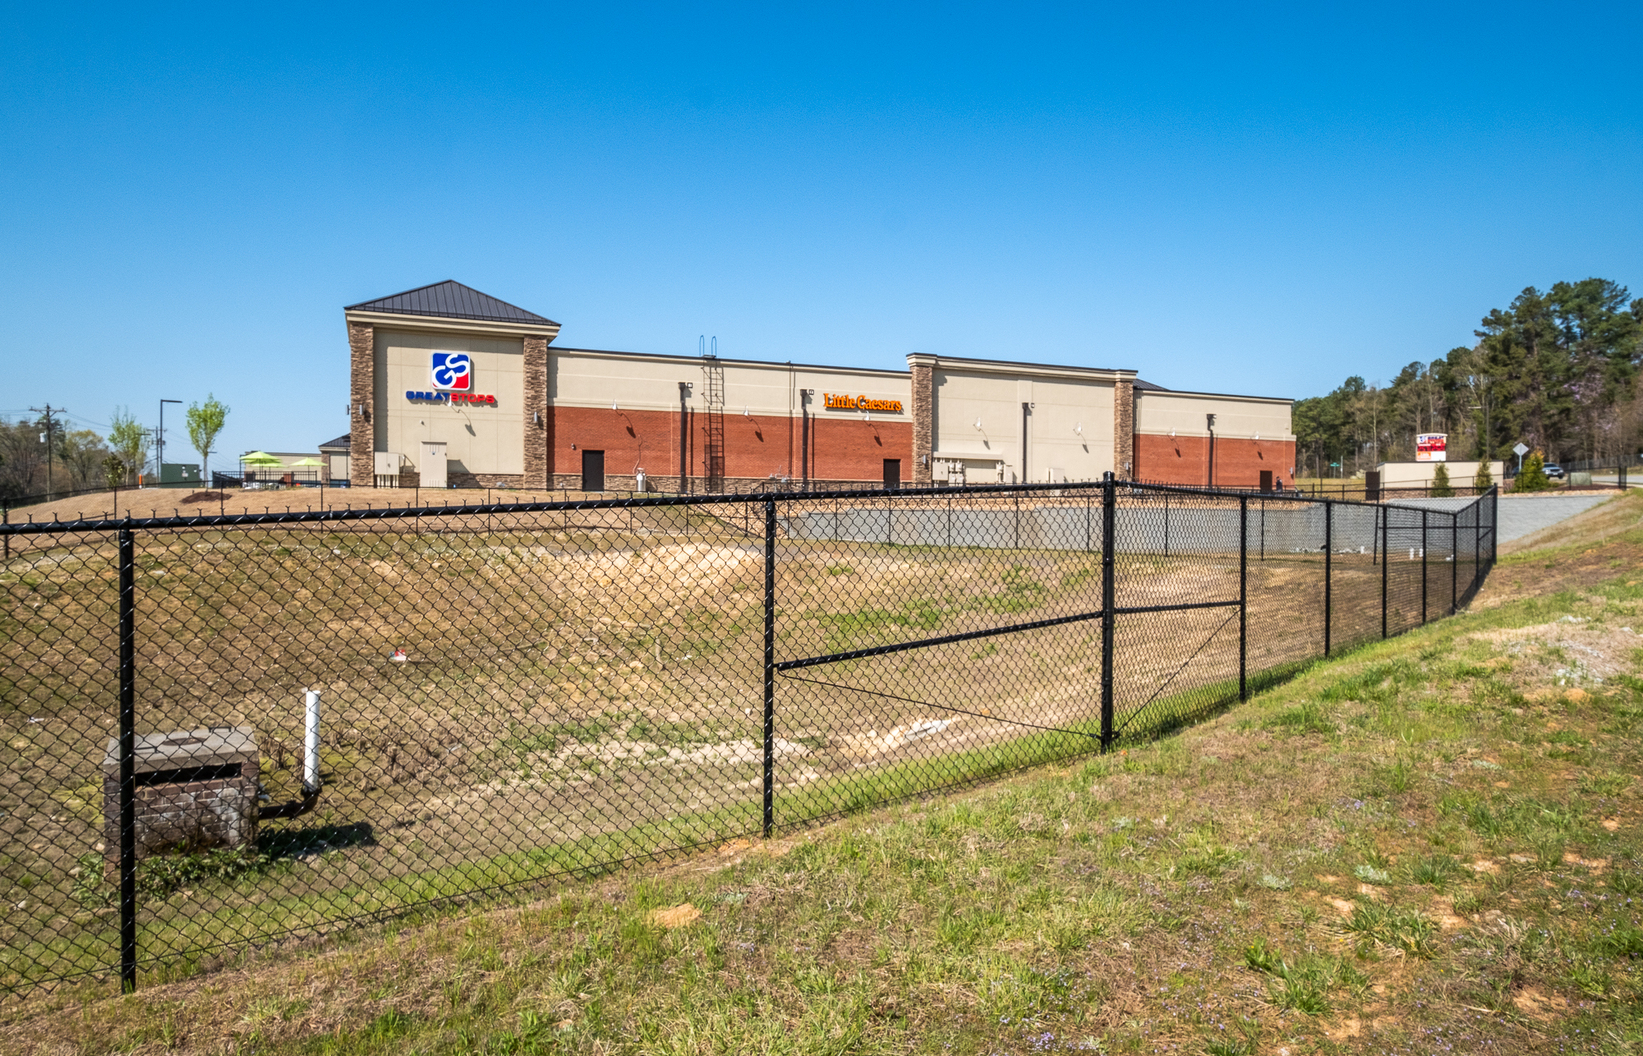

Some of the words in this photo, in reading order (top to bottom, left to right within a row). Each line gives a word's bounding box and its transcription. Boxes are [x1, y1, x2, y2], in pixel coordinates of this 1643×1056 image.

[432, 353, 470, 389] GS
[823, 393, 856, 409] Little
[857, 395, 902, 411] Caesars
